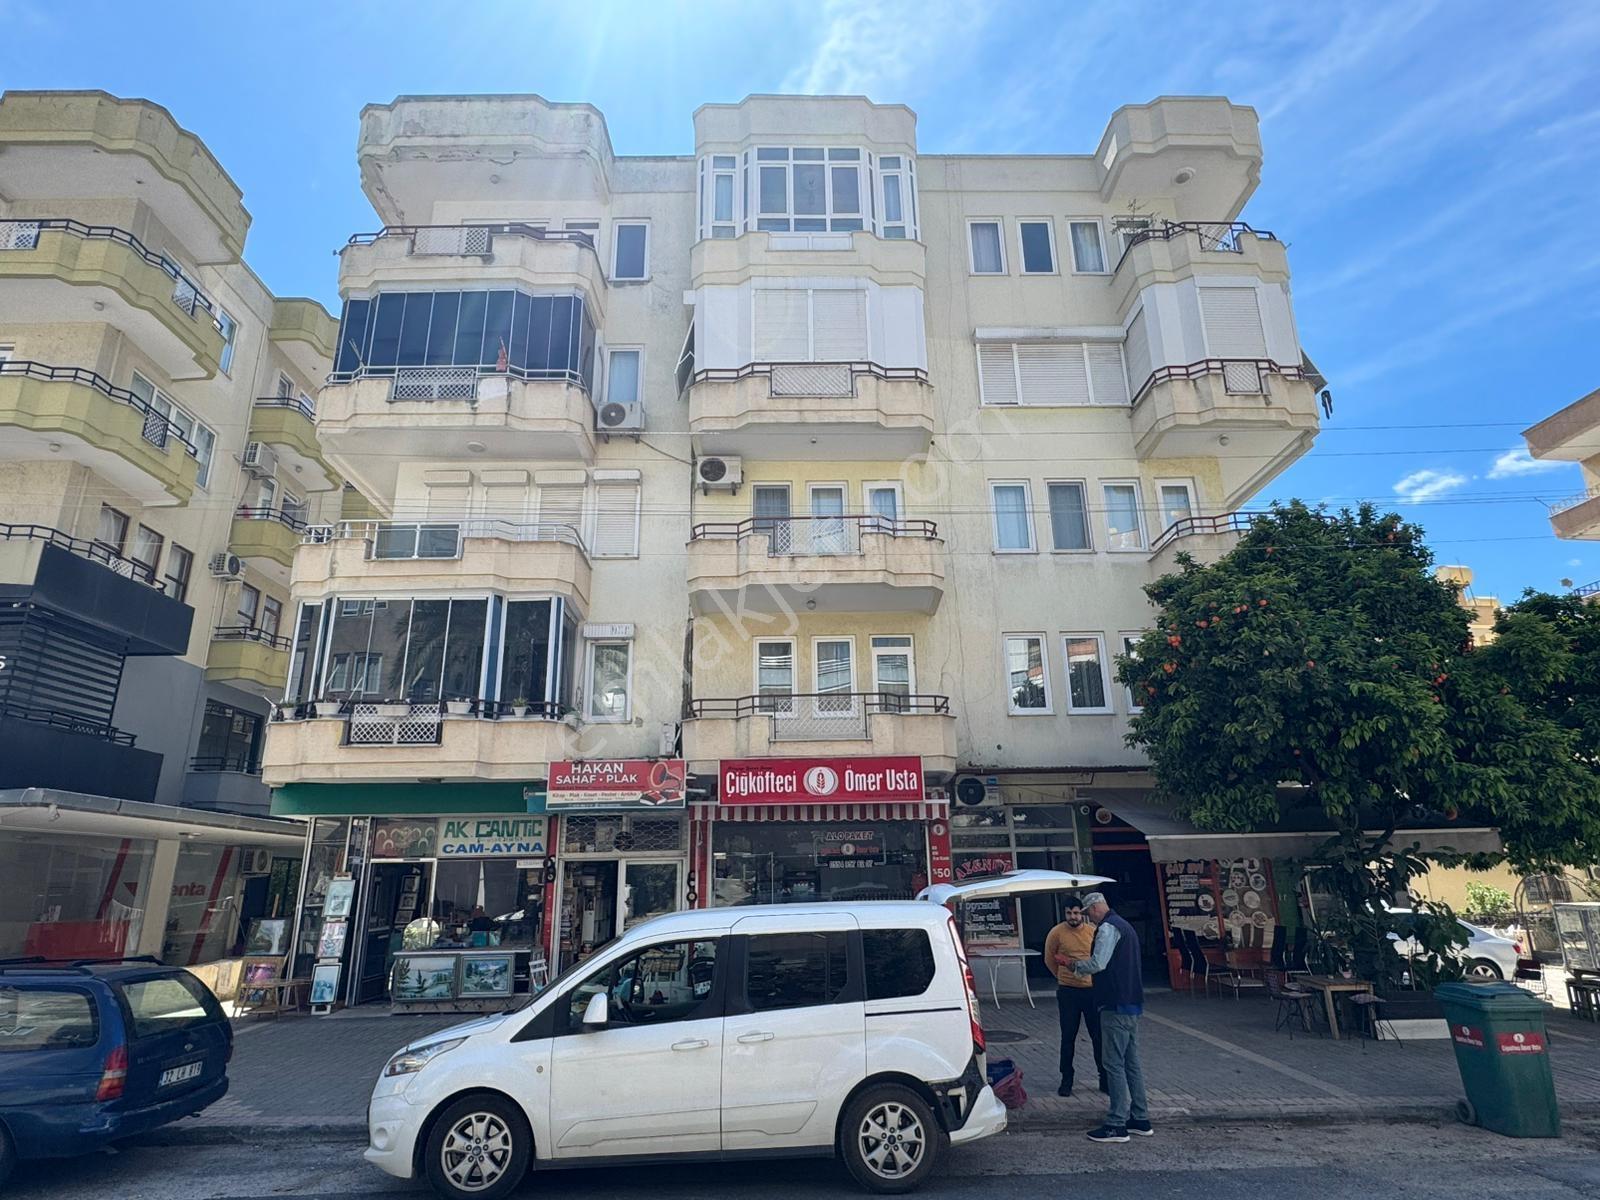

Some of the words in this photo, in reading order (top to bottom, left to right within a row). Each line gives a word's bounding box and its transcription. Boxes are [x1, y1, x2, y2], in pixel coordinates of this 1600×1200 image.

[571, 762, 624, 774] HAKAN
[555, 775, 597, 785] SAHAF
[606, 774, 638, 784] PLAK
[726, 770, 797, 798] Çiğköfteci
[845, 764, 883, 792] Ömer
[886, 768, 918, 791] Usta
[443, 821, 469, 838] AK
[442, 842, 544, 854] CAM-AYNA
